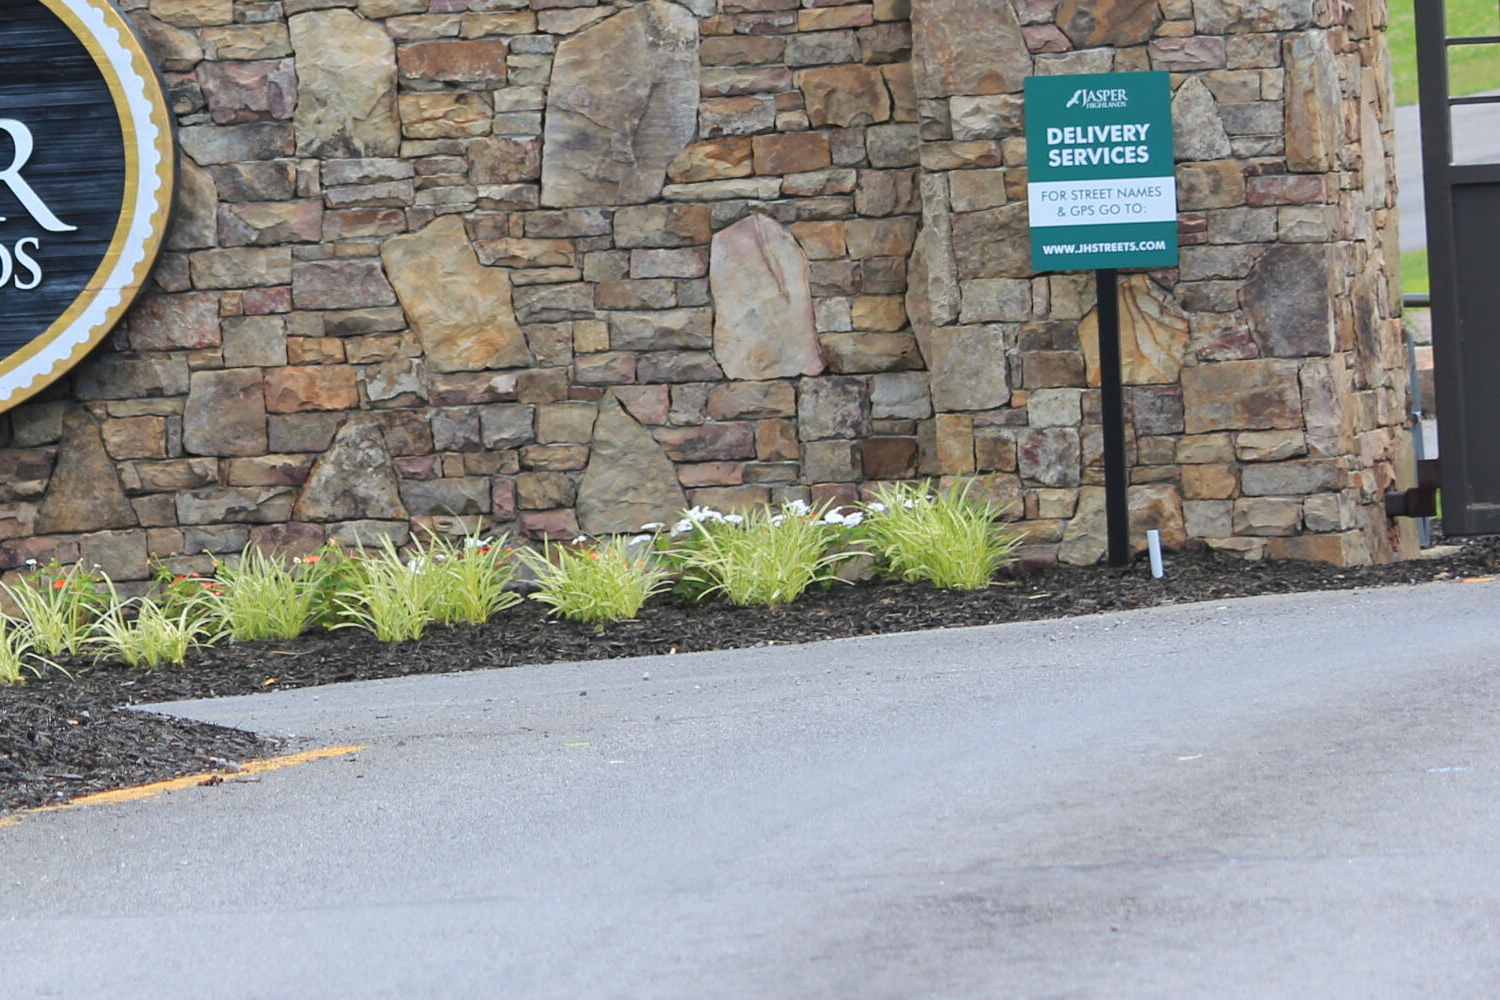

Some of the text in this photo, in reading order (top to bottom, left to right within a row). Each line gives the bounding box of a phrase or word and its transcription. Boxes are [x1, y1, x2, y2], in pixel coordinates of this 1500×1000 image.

[1082, 88, 1128, 107] JASPER
[1086, 101, 1127, 109] HIGHLANDS
[1046, 123, 1150, 145] DELIVERY
[1048, 146, 1150, 167] SERVICES
[1041, 186, 1162, 202] FOR STREET NAMES
[1057, 203, 1147, 217] & GPS GO TO:
[1043, 240, 1166, 255] WWW.JHSTREETS.COM
